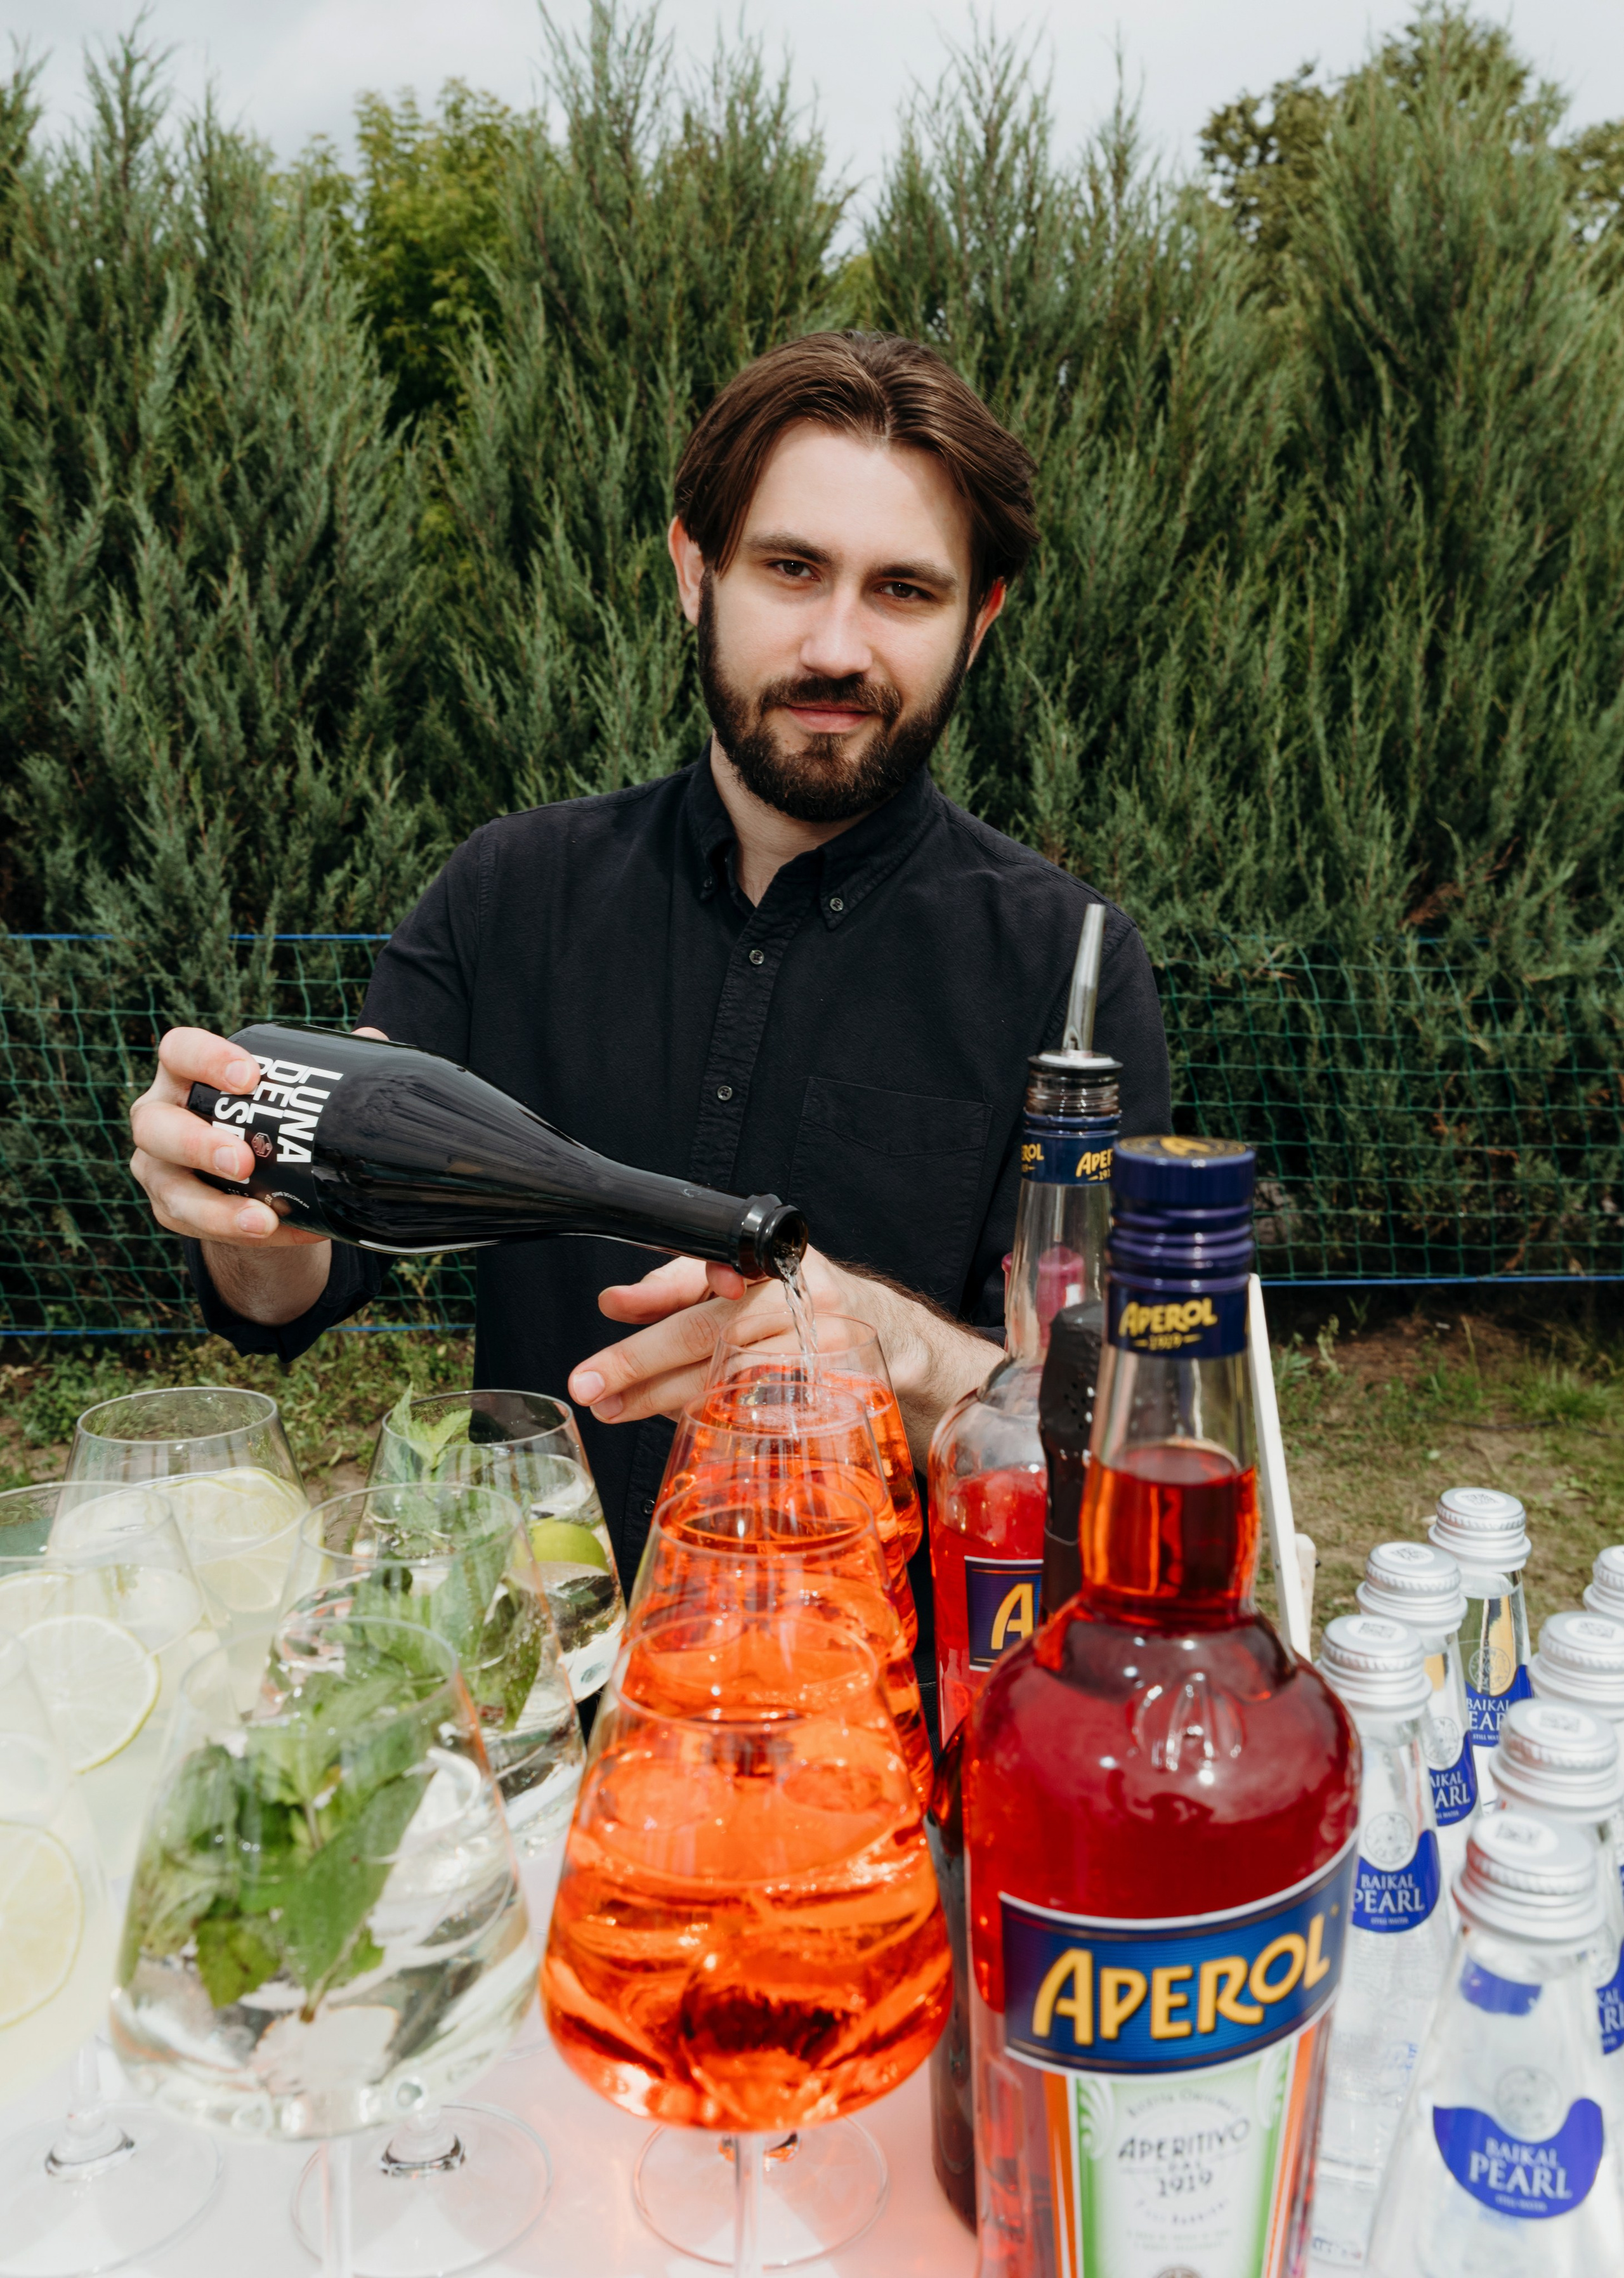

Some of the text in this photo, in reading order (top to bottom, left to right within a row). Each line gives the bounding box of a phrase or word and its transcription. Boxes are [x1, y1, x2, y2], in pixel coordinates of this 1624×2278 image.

[246, 1059, 310, 1124] DEL
[277, 1067, 344, 1163] LUNA
[1118, 1297, 1218, 1337] APEROL
[1352, 1887, 1425, 1915] PEARL
[1361, 1874, 1416, 1890] BAIKAL
[1032, 1913, 1331, 2046] APEROL
[1118, 2116, 1252, 2160] APERITIVO
[1485, 2137, 1561, 2170] BAIKAL
[1158, 2168, 1213, 2197] 1919
[1468, 2150, 1573, 2200] PEARL
